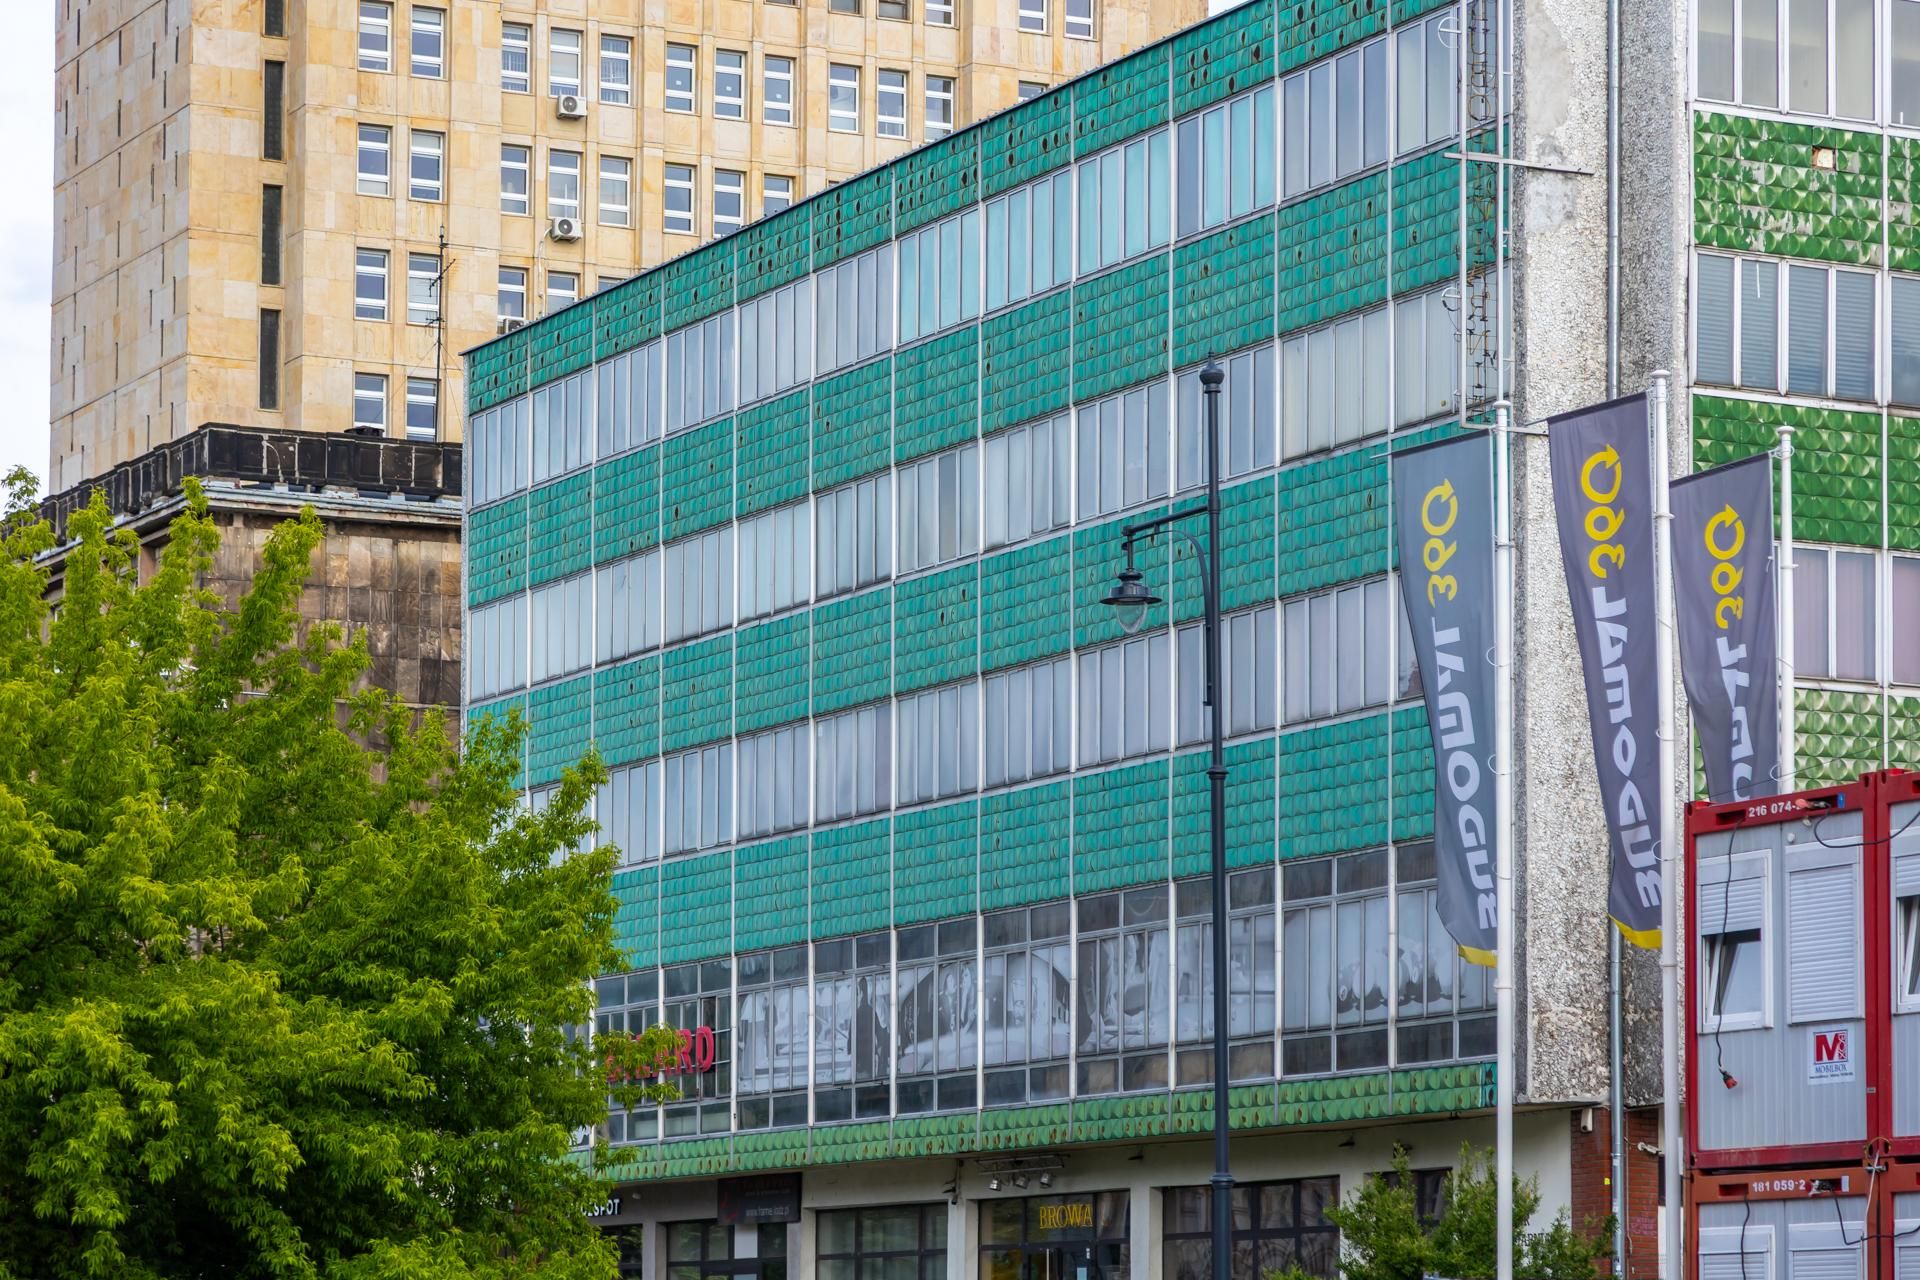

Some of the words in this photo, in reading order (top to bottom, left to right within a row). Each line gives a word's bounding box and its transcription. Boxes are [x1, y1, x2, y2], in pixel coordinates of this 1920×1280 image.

[1748, 805, 1767, 817] 216
[1815, 1063, 1848, 1073] MOBILBOX
[1752, 1181, 1770, 1192] 181
